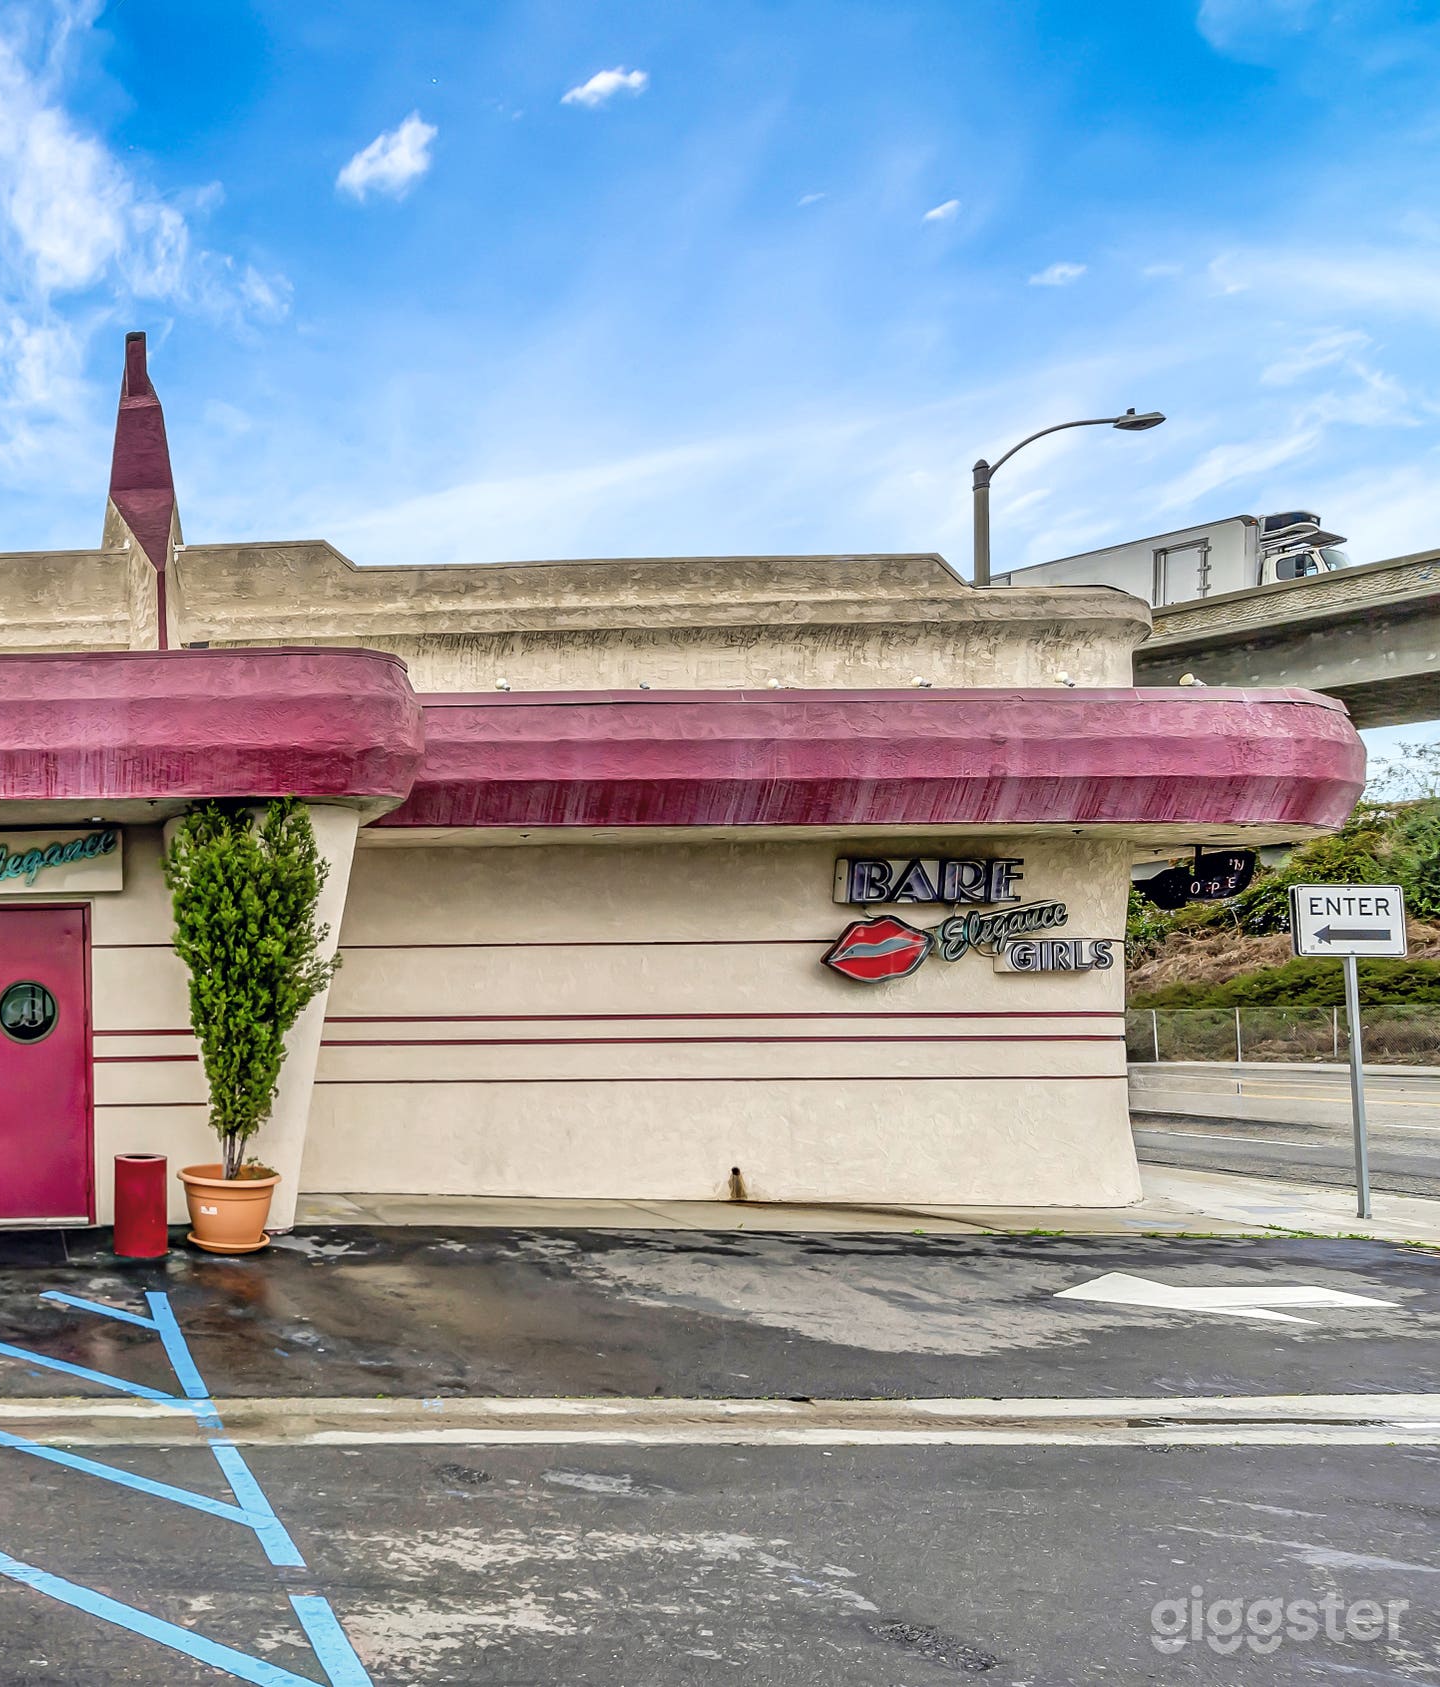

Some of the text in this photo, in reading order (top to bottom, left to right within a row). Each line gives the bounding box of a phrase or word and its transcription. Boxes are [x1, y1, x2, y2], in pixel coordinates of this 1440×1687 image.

[851, 858, 1025, 904] BARE
[1309, 897, 1391, 917] ENTER
[939, 902, 1069, 962] Elegance
[1010, 940, 1115, 970] GIRLS
